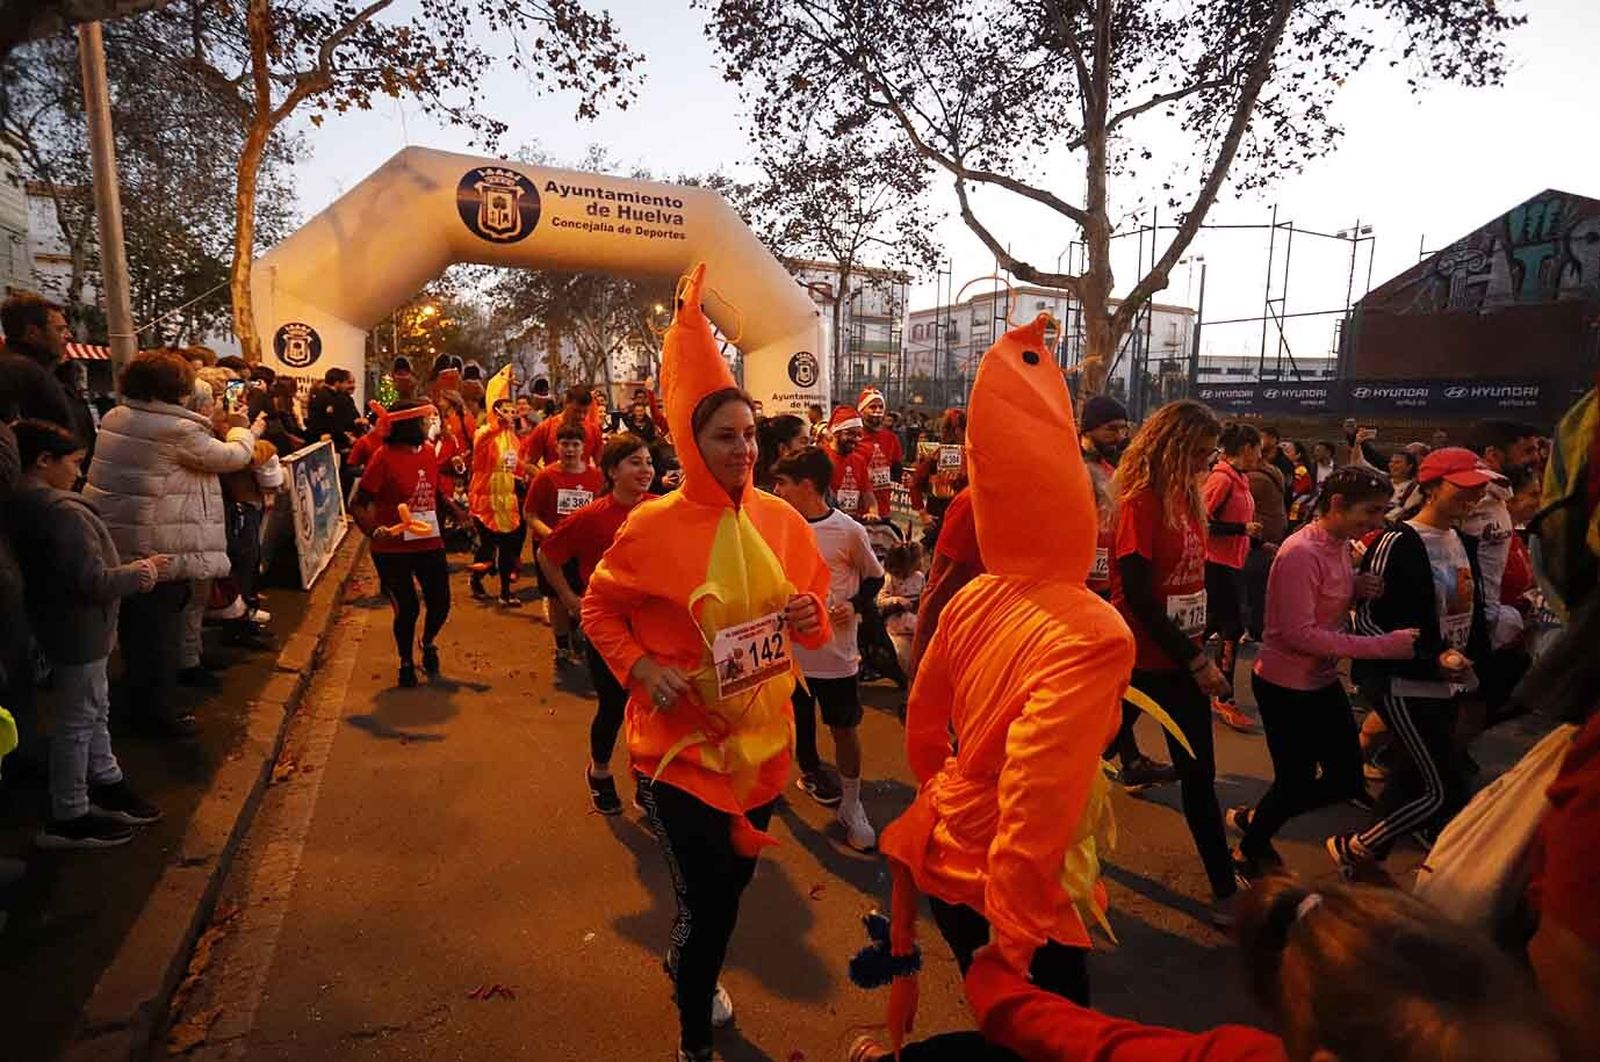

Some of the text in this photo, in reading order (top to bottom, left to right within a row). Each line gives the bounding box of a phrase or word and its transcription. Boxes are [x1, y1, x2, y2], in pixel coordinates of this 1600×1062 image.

[544, 180, 684, 209] Ayuntamiento
[586, 201, 684, 226] de Huelva
[617, 223, 632, 235] de
[635, 226, 686, 240] Deportes
[1214, 389, 1254, 399] HYUNDAI
[1281, 388, 1327, 398] HYUNDAI
[1372, 387, 1430, 398] HYUNDAI
[1469, 386, 1540, 398] HYUNDAI
[790, 401, 801, 409] de
[749, 633, 784, 667] 142
